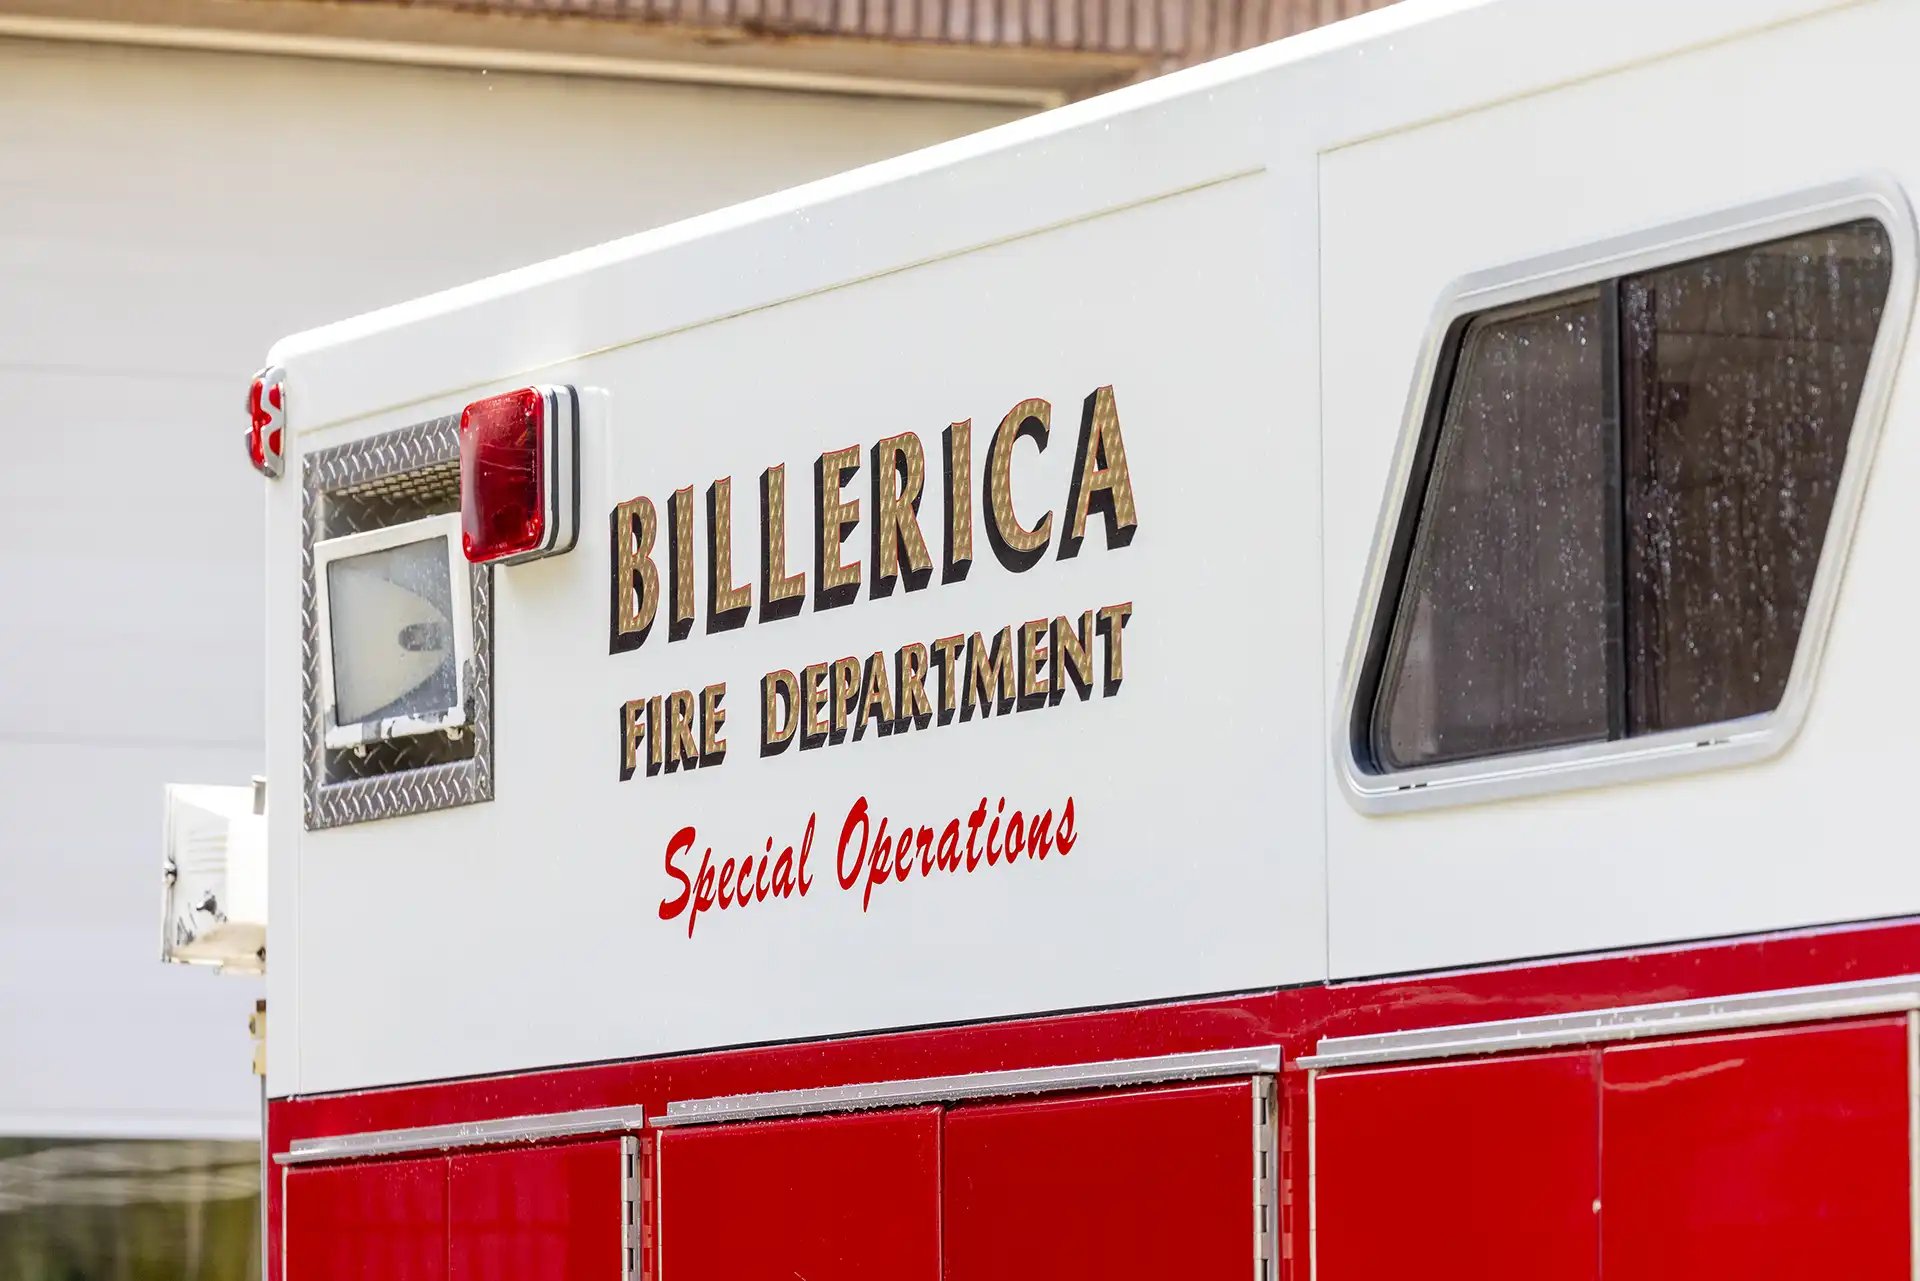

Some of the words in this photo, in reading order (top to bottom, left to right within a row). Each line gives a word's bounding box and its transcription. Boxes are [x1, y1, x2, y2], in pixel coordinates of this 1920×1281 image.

[608, 384, 1138, 655] BILLERICA
[619, 682, 727, 782] FIRE
[760, 601, 1132, 758] DEPARTMENT
[658, 811, 815, 938] Special
[836, 796, 1077, 912] Operations
